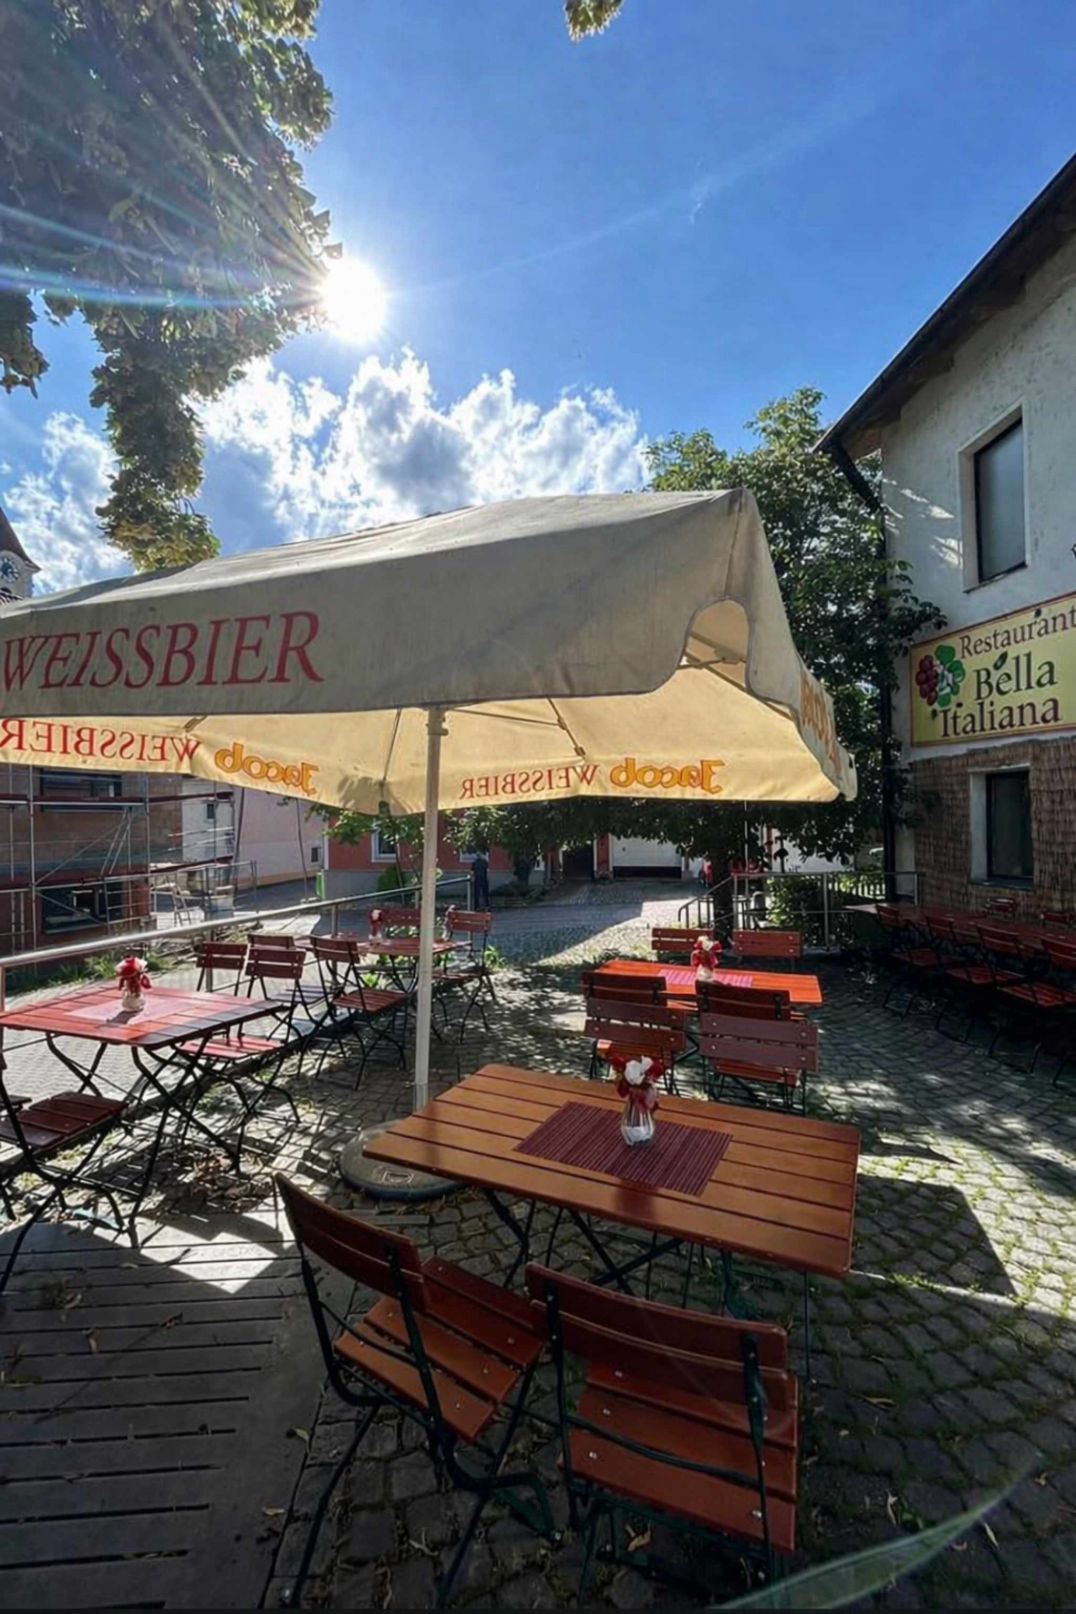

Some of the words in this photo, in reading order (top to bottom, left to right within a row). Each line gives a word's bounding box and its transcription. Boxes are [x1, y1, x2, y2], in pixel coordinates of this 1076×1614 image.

[4, 611, 325, 692] WEISSBIER
[959, 604, 1076, 659] Restaurant
[973, 651, 1058, 701] Bella
[939, 697, 1063, 738] Italiana
